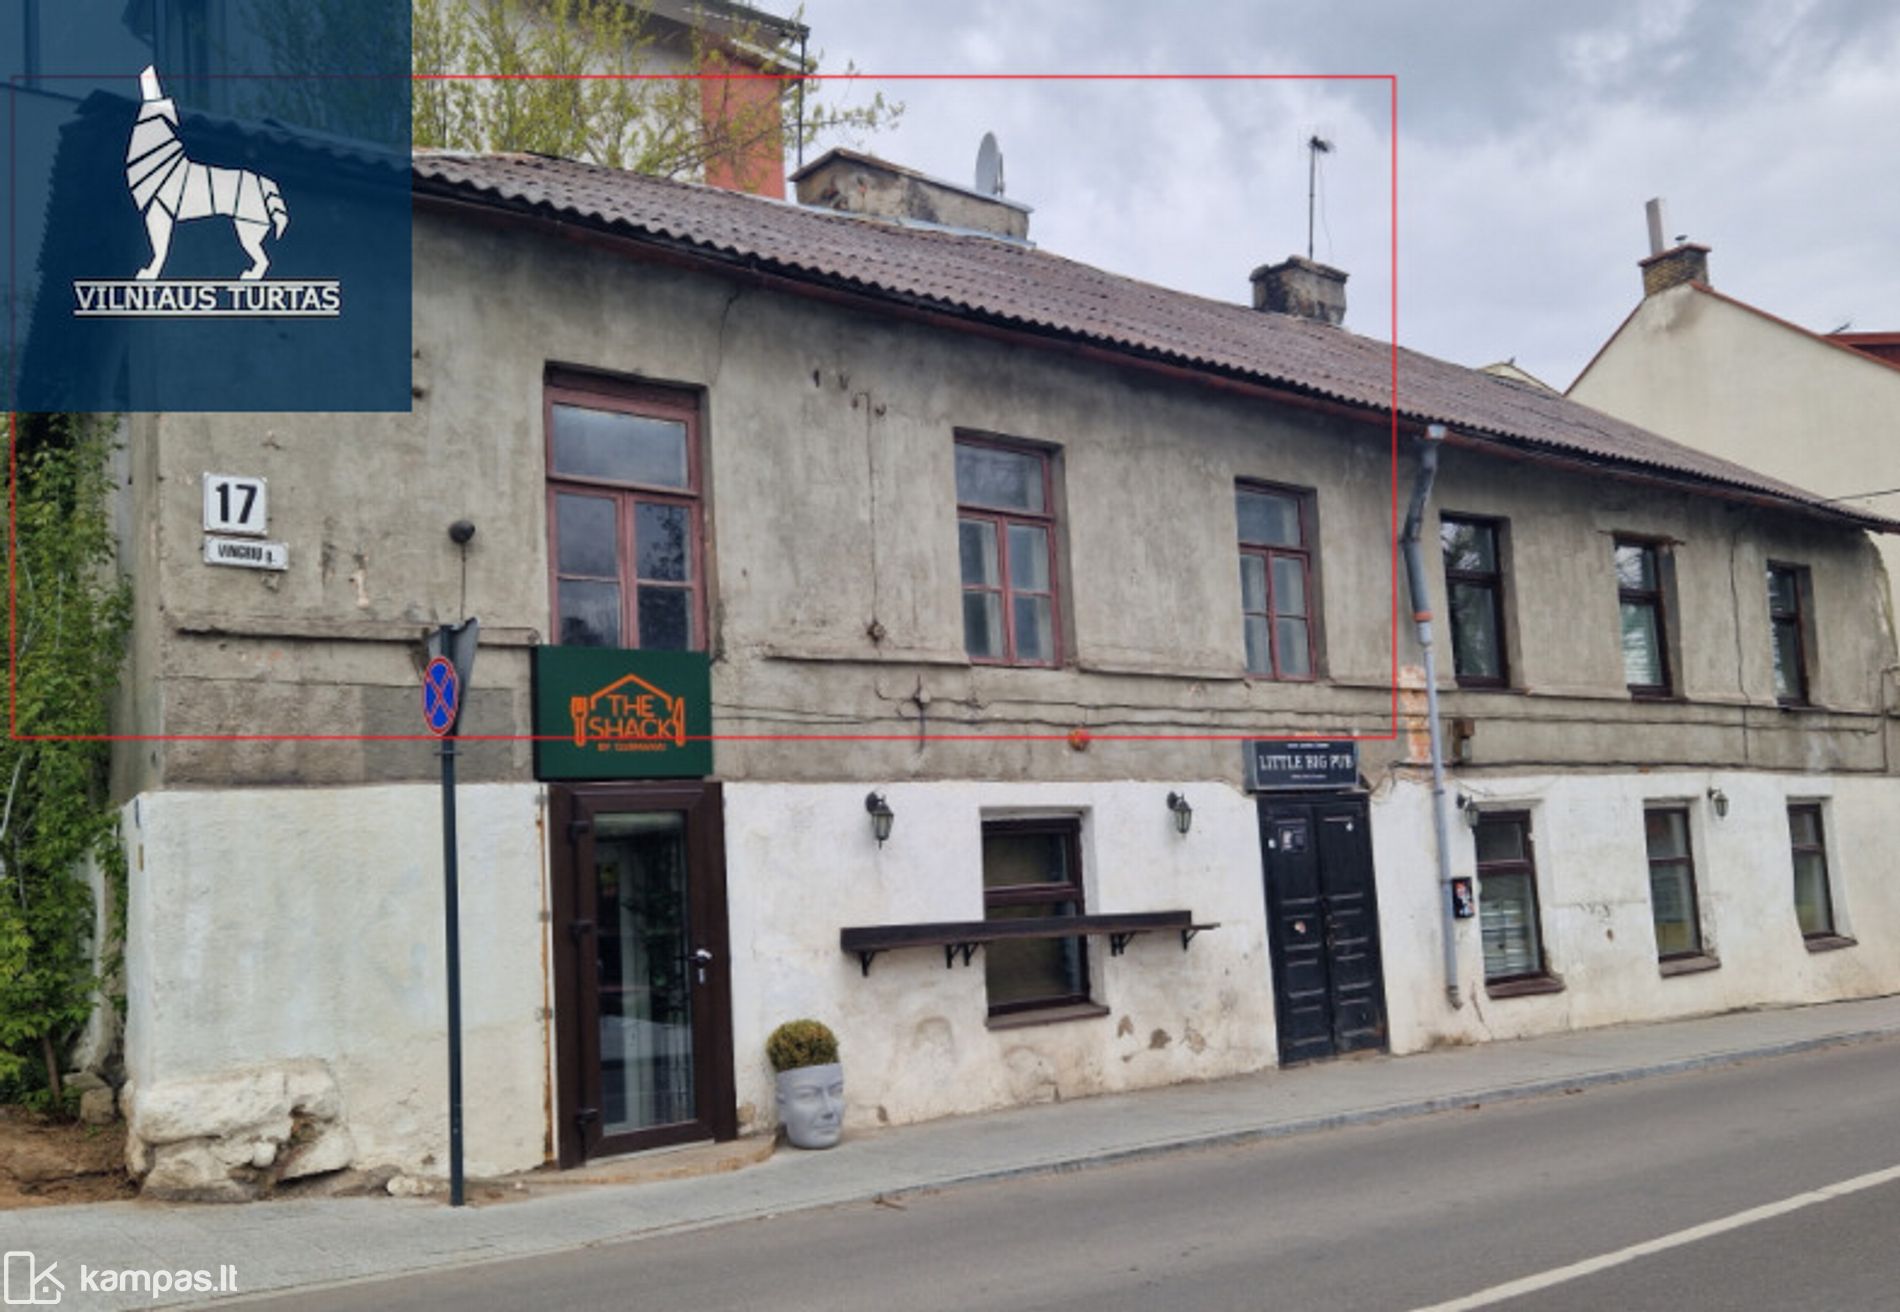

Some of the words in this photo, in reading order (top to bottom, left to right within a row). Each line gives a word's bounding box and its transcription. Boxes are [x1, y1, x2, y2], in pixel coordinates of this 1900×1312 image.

[216, 482, 258, 524] 17
[607, 693, 656, 718] THE
[588, 716, 675, 738] SHACK
[1259, 754, 1302, 771] LITTLE
[1304, 754, 1328, 770] BIG
[1330, 753, 1354, 770] PUB
